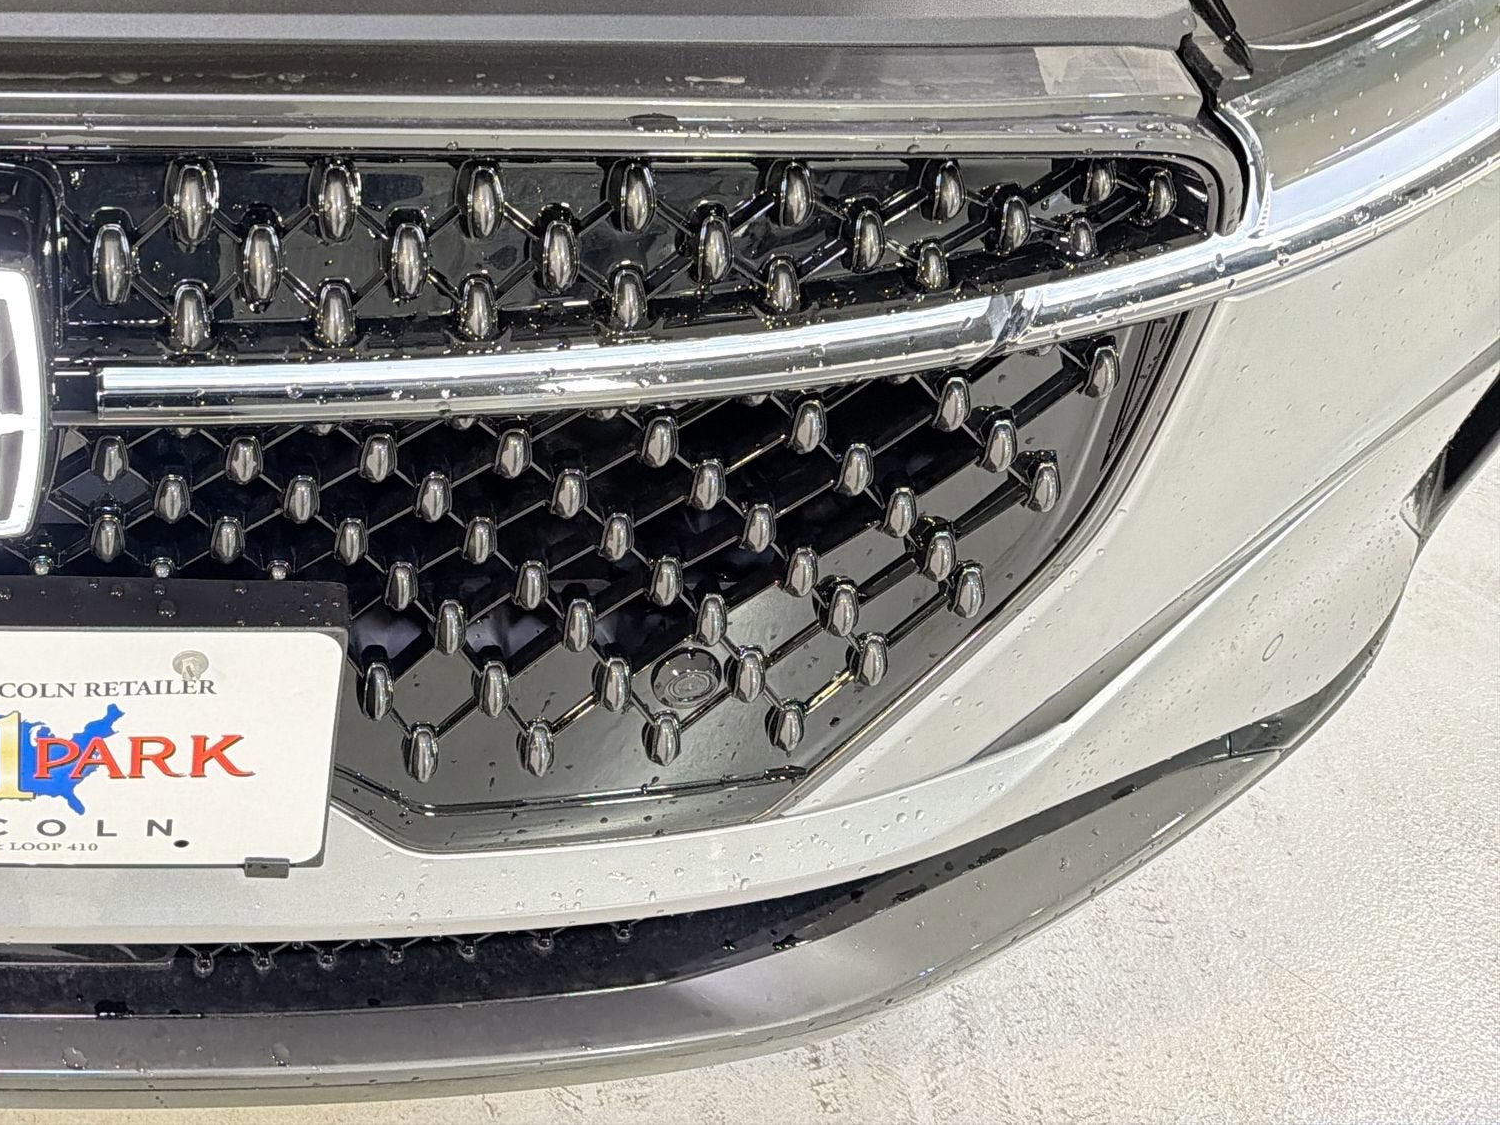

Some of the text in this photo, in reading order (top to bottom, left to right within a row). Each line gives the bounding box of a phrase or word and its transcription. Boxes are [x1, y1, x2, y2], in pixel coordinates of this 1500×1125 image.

[83, 679, 217, 697] RETAILER
[35, 734, 255, 779] PARK
[10, 842, 63, 852] LOOP
[66, 843, 99, 852] 410
